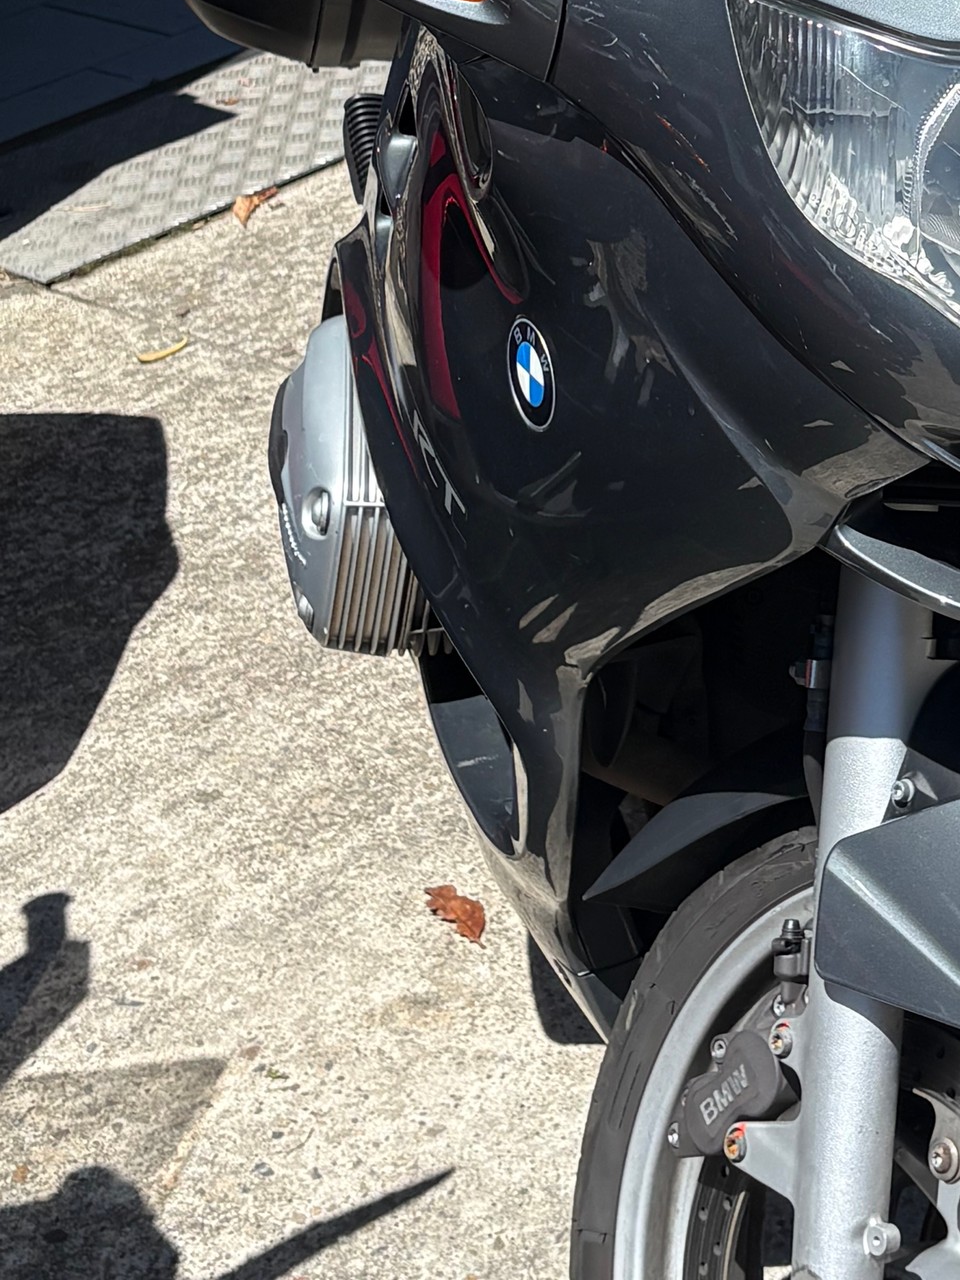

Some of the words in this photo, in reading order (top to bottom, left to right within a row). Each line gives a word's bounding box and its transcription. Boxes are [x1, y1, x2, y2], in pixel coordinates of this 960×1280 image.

[513, 326, 549, 373] BMW
[412, 409, 466, 516] RT
[700, 1064, 749, 1126] BMW
